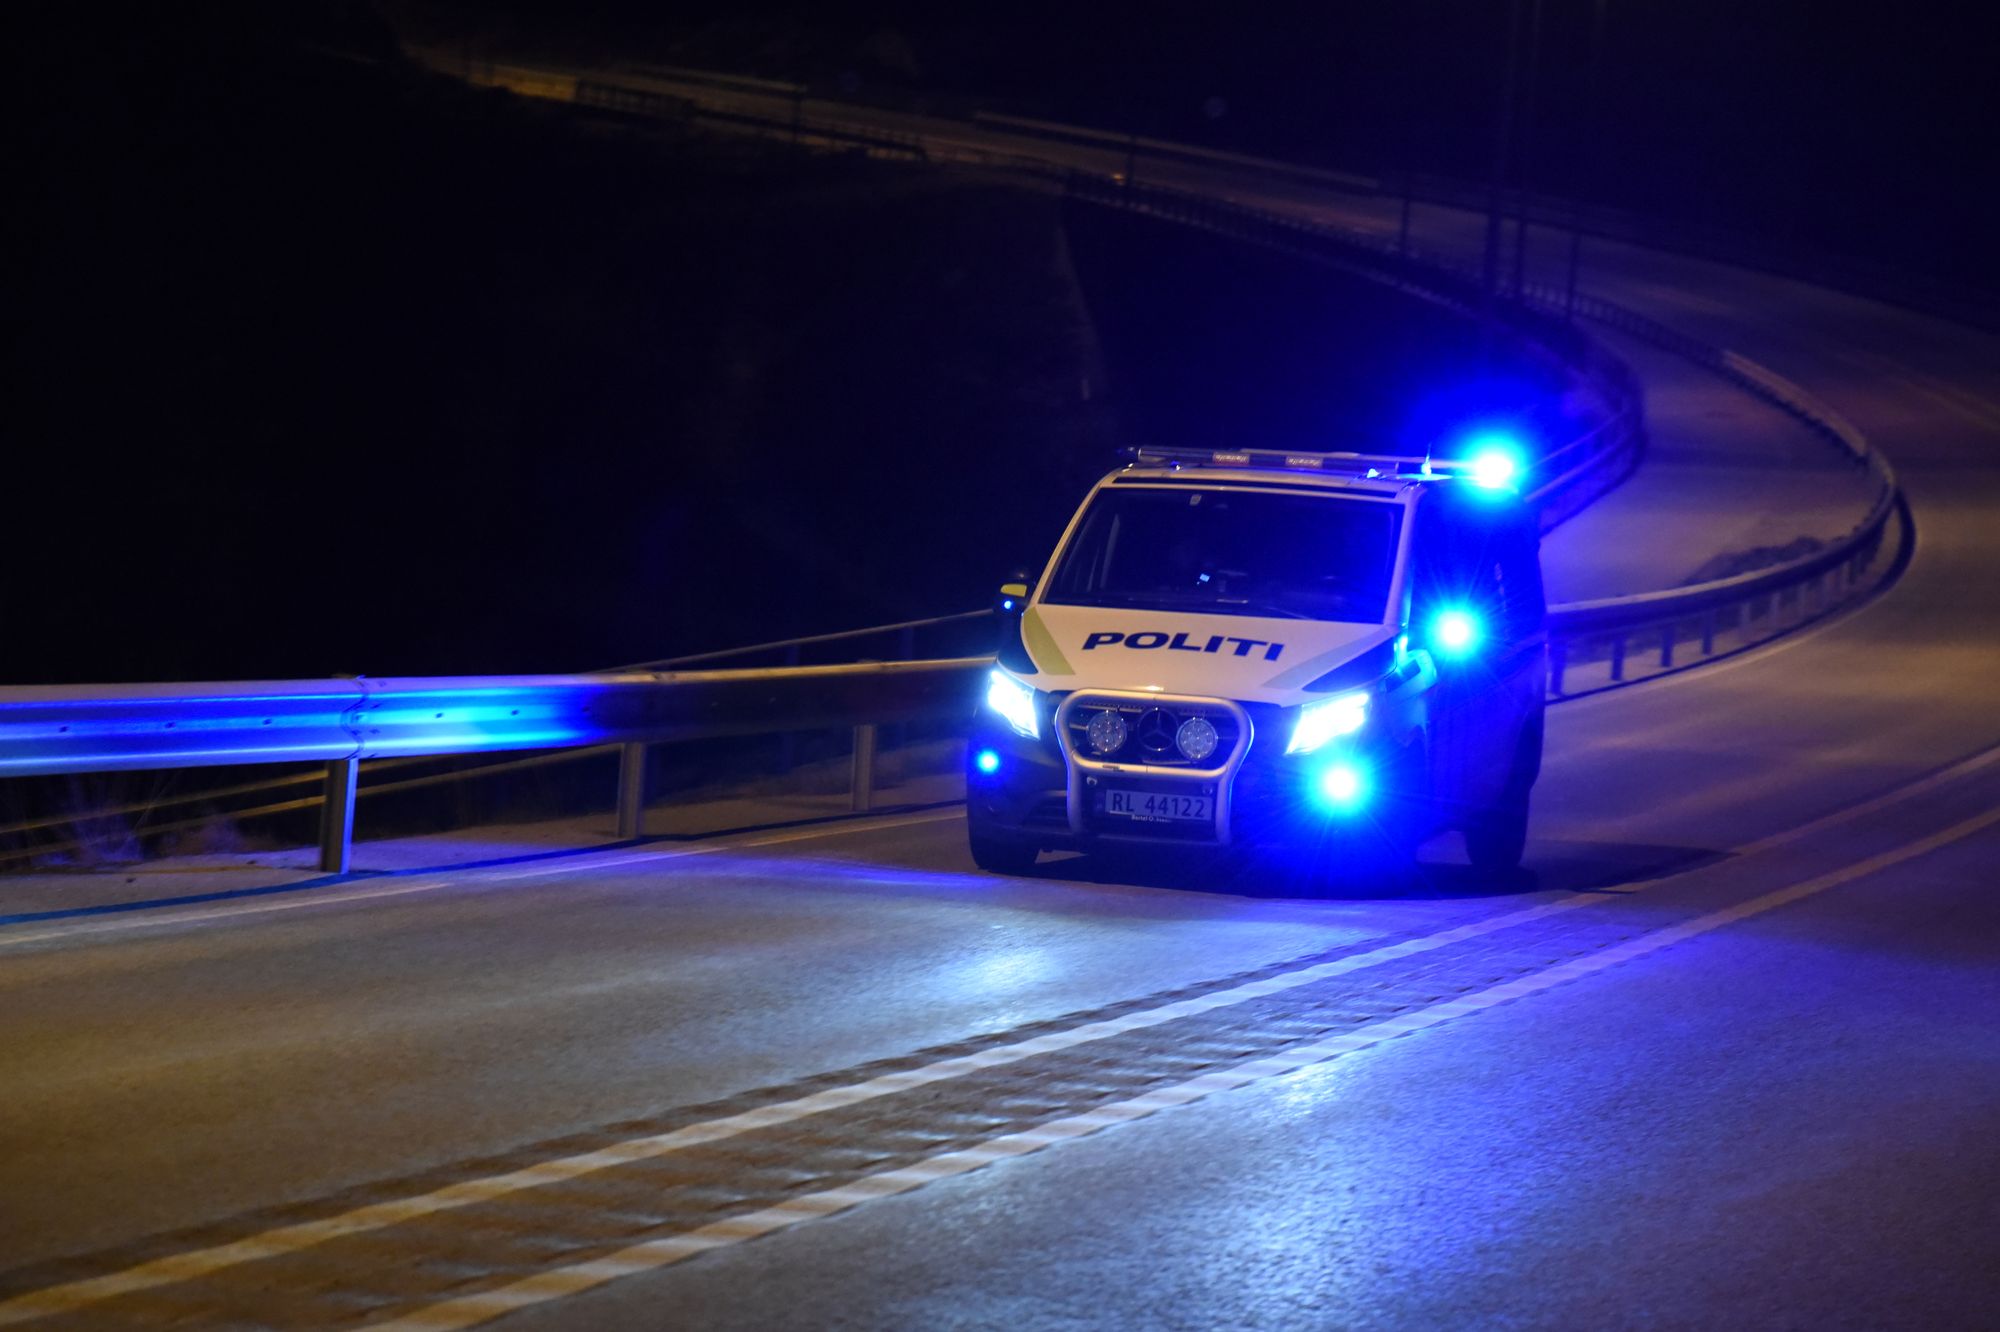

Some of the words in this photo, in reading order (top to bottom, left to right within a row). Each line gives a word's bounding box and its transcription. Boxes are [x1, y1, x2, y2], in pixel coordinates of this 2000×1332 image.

[1082, 632, 1284, 661] POLITI
[1112, 793, 1134, 812] RL
[1144, 796, 1205, 818] 44122
